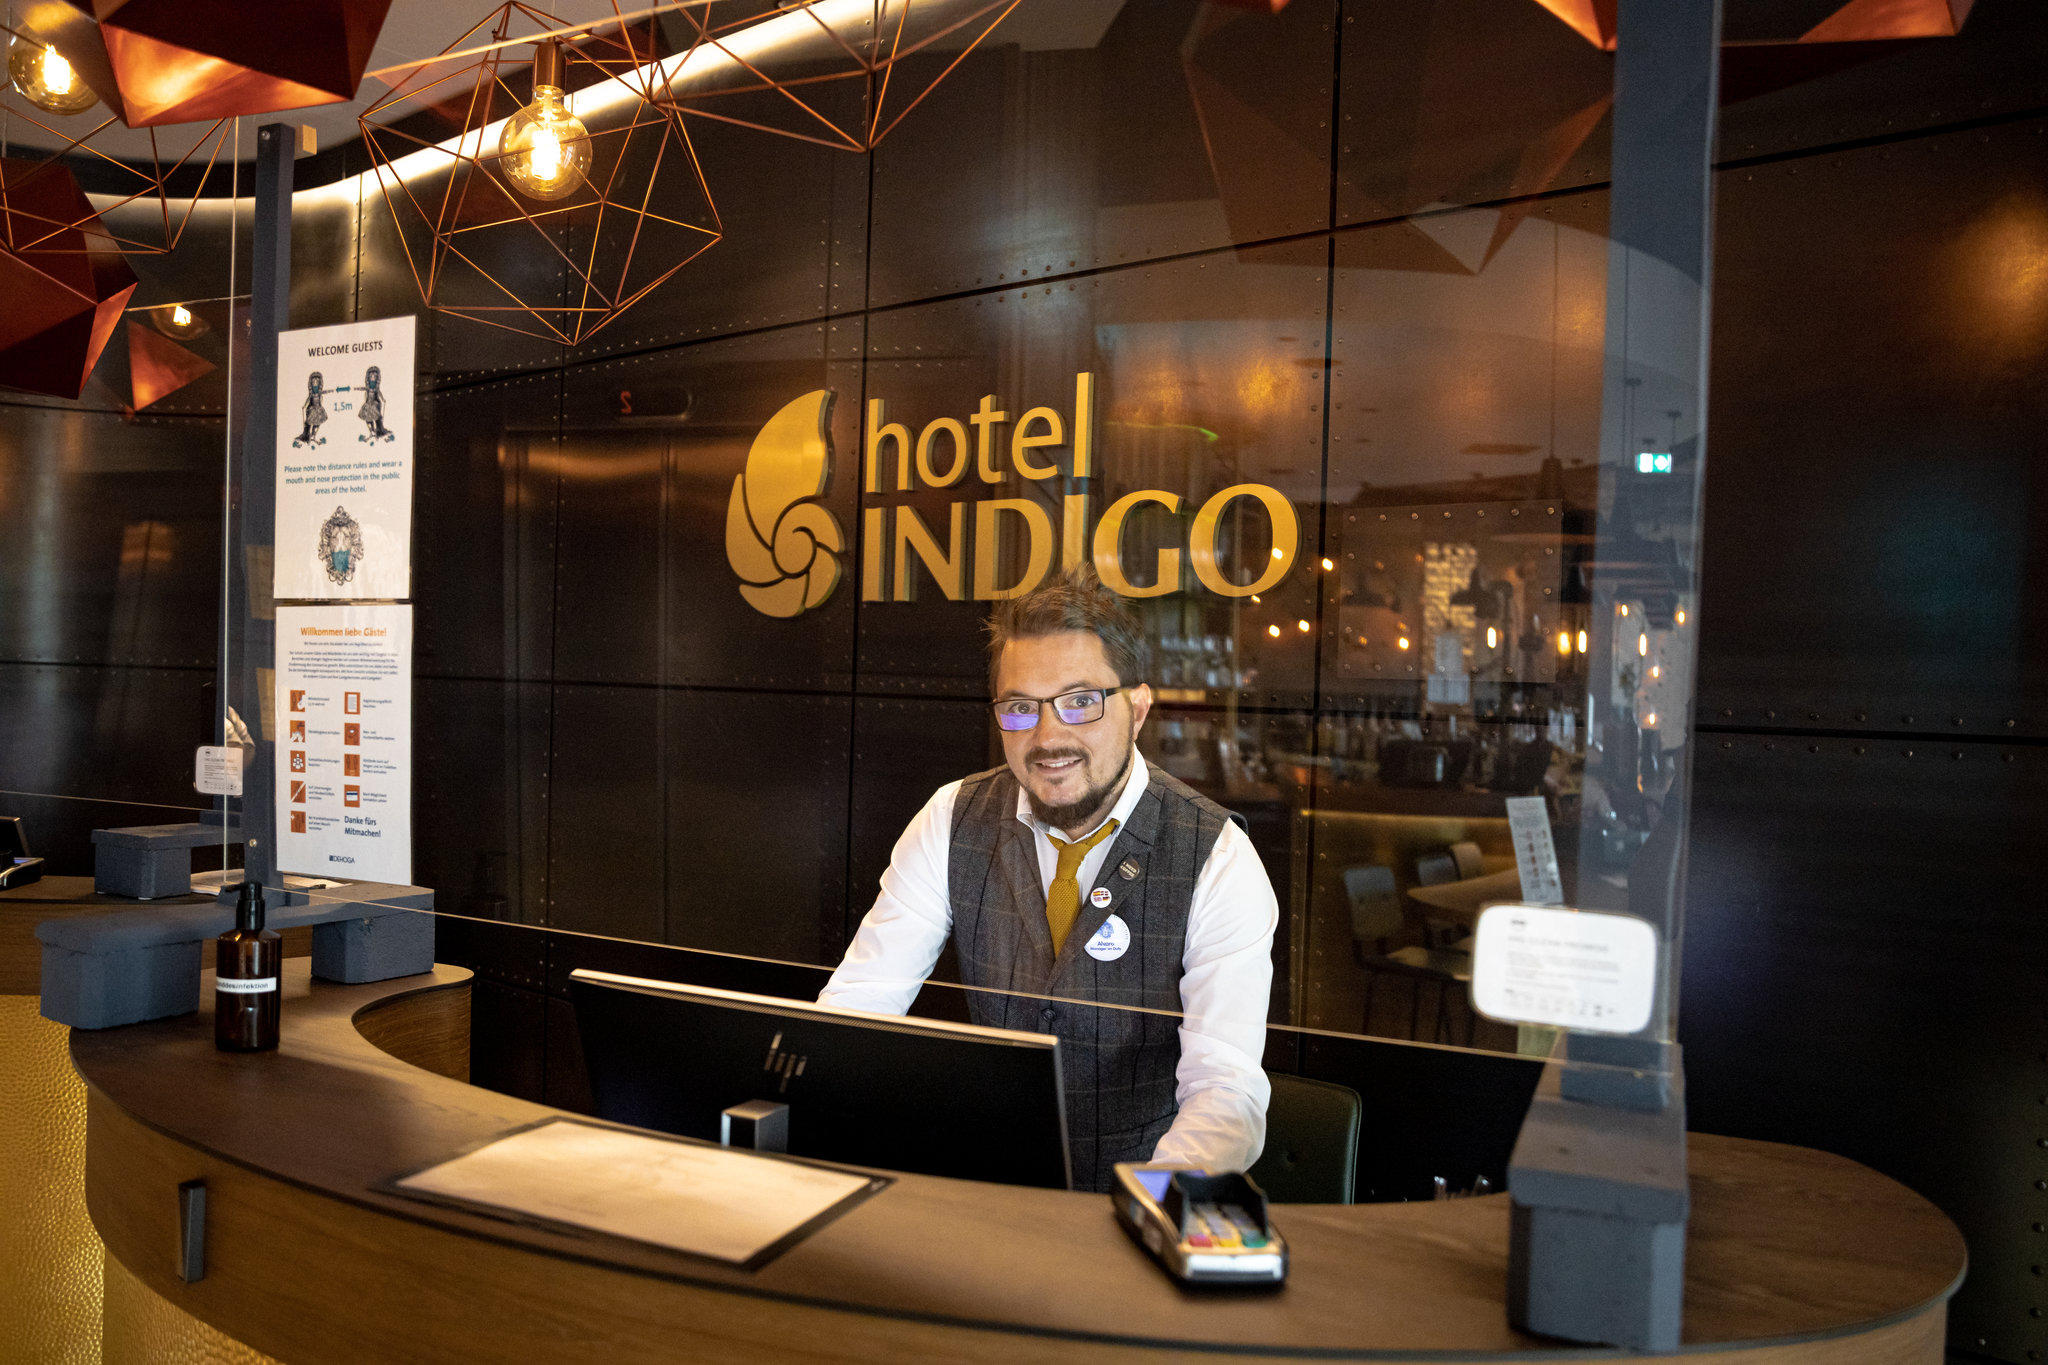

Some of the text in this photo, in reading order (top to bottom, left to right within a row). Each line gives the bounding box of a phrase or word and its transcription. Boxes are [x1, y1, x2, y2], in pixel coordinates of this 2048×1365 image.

[308, 340, 384, 357] WELCOME GUESTS
[334, 401, 353, 412] 1,5m
[865, 371, 1094, 493] hotel
[284, 465, 302, 473] Please
[303, 464, 316, 472] note
[317, 463, 327, 471] the
[328, 462, 351, 471] distance
[353, 461, 367, 469] rules
[285, 476, 304, 484] mouth
[305, 475, 316, 483] and
[331, 474, 361, 482] protection
[370, 472, 380, 480] the
[381, 472, 400, 481] public
[315, 487, 330, 495] areas
[338, 485, 348, 493] the
[349, 484, 367, 493] hotel.
[862, 483, 1300, 601] INDIGO
[300, 626, 387, 637] Willkommen liebe Gäste!
[344, 816, 363, 825] Danke
[364, 816, 376, 826] fürs
[344, 827, 381, 838] Mitmachen!
[333, 855, 355, 864] DEHOGA
[763, 1031, 808, 1093] hp
